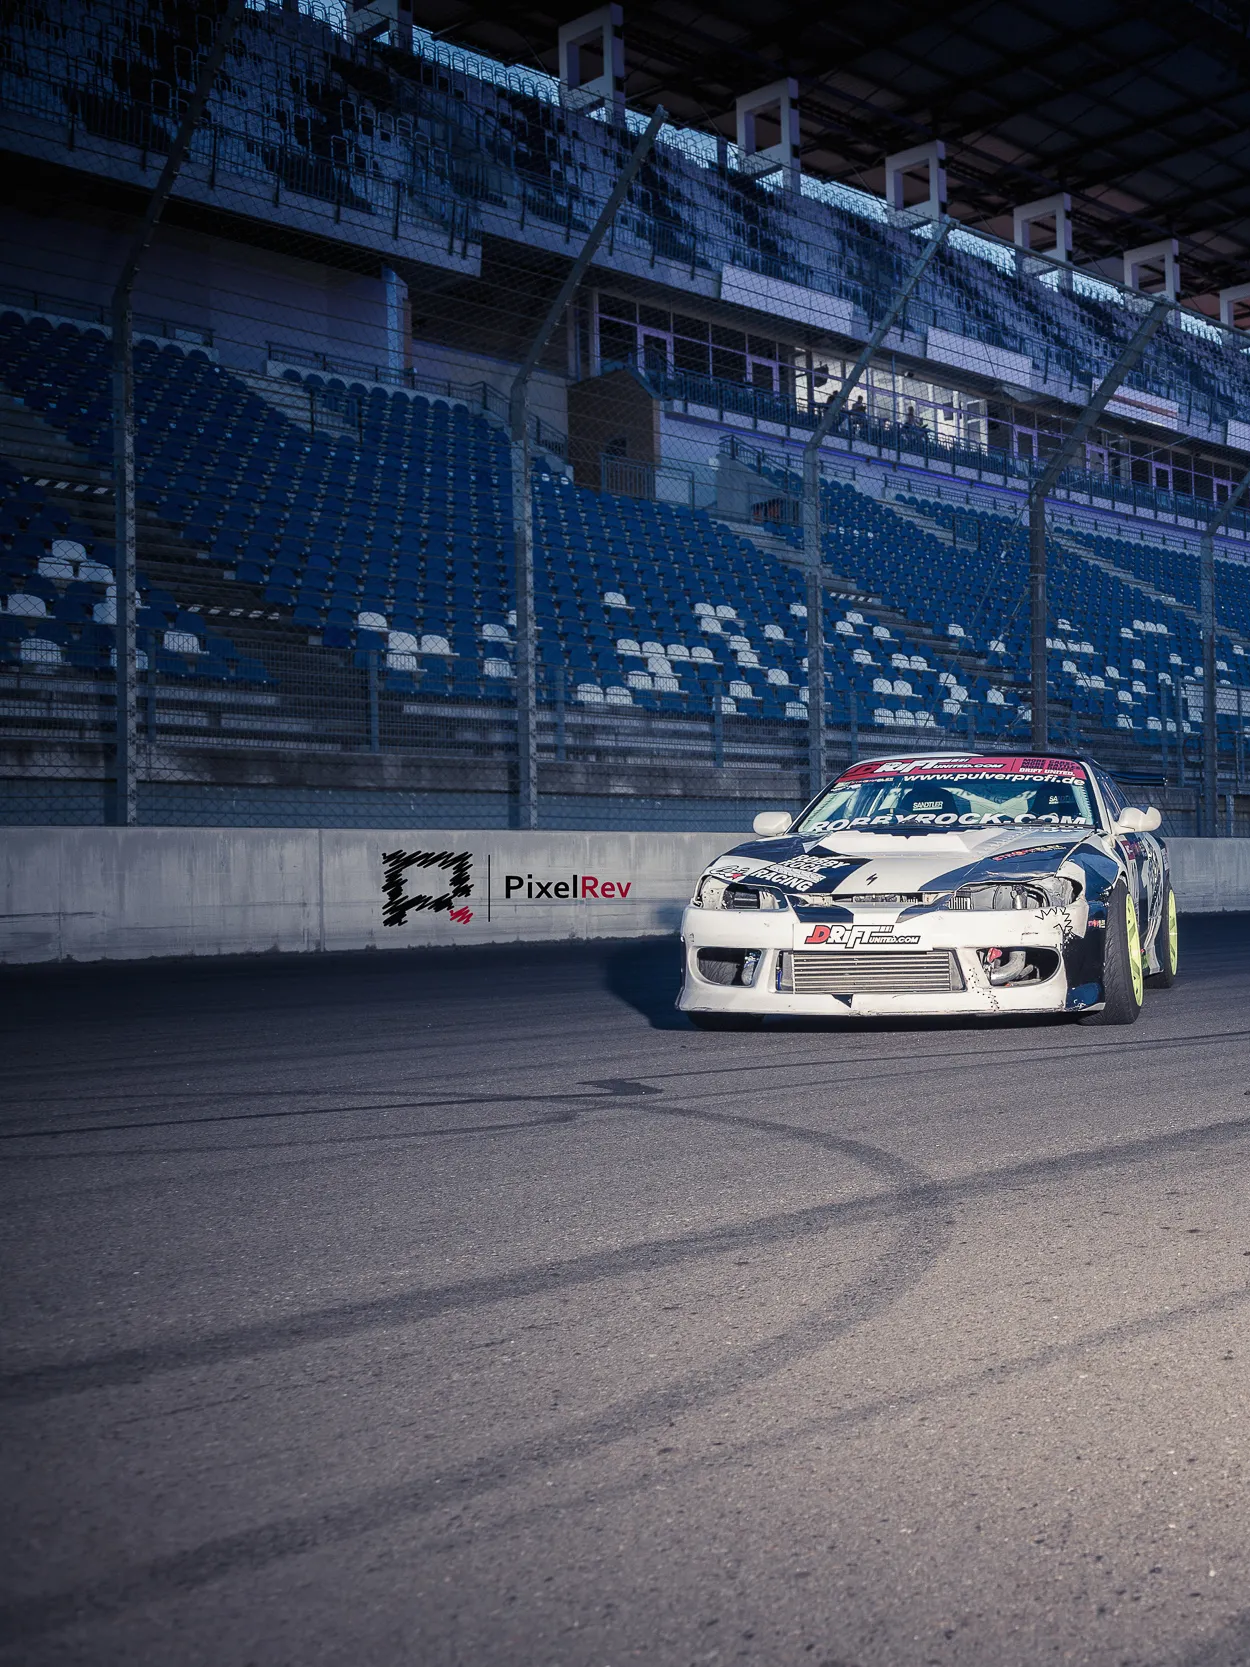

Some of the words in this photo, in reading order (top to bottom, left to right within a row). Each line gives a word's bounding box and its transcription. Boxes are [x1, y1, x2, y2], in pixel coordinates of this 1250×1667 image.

[904, 772, 1085, 786] www.pulverprofi.de
[913, 801, 943, 810] SANDTLER
[778, 860, 827, 872] ROCK
[792, 854, 850, 868] ROBBY
[752, 869, 813, 891] RACING
[869, 935, 920, 944] UNITED.COM
